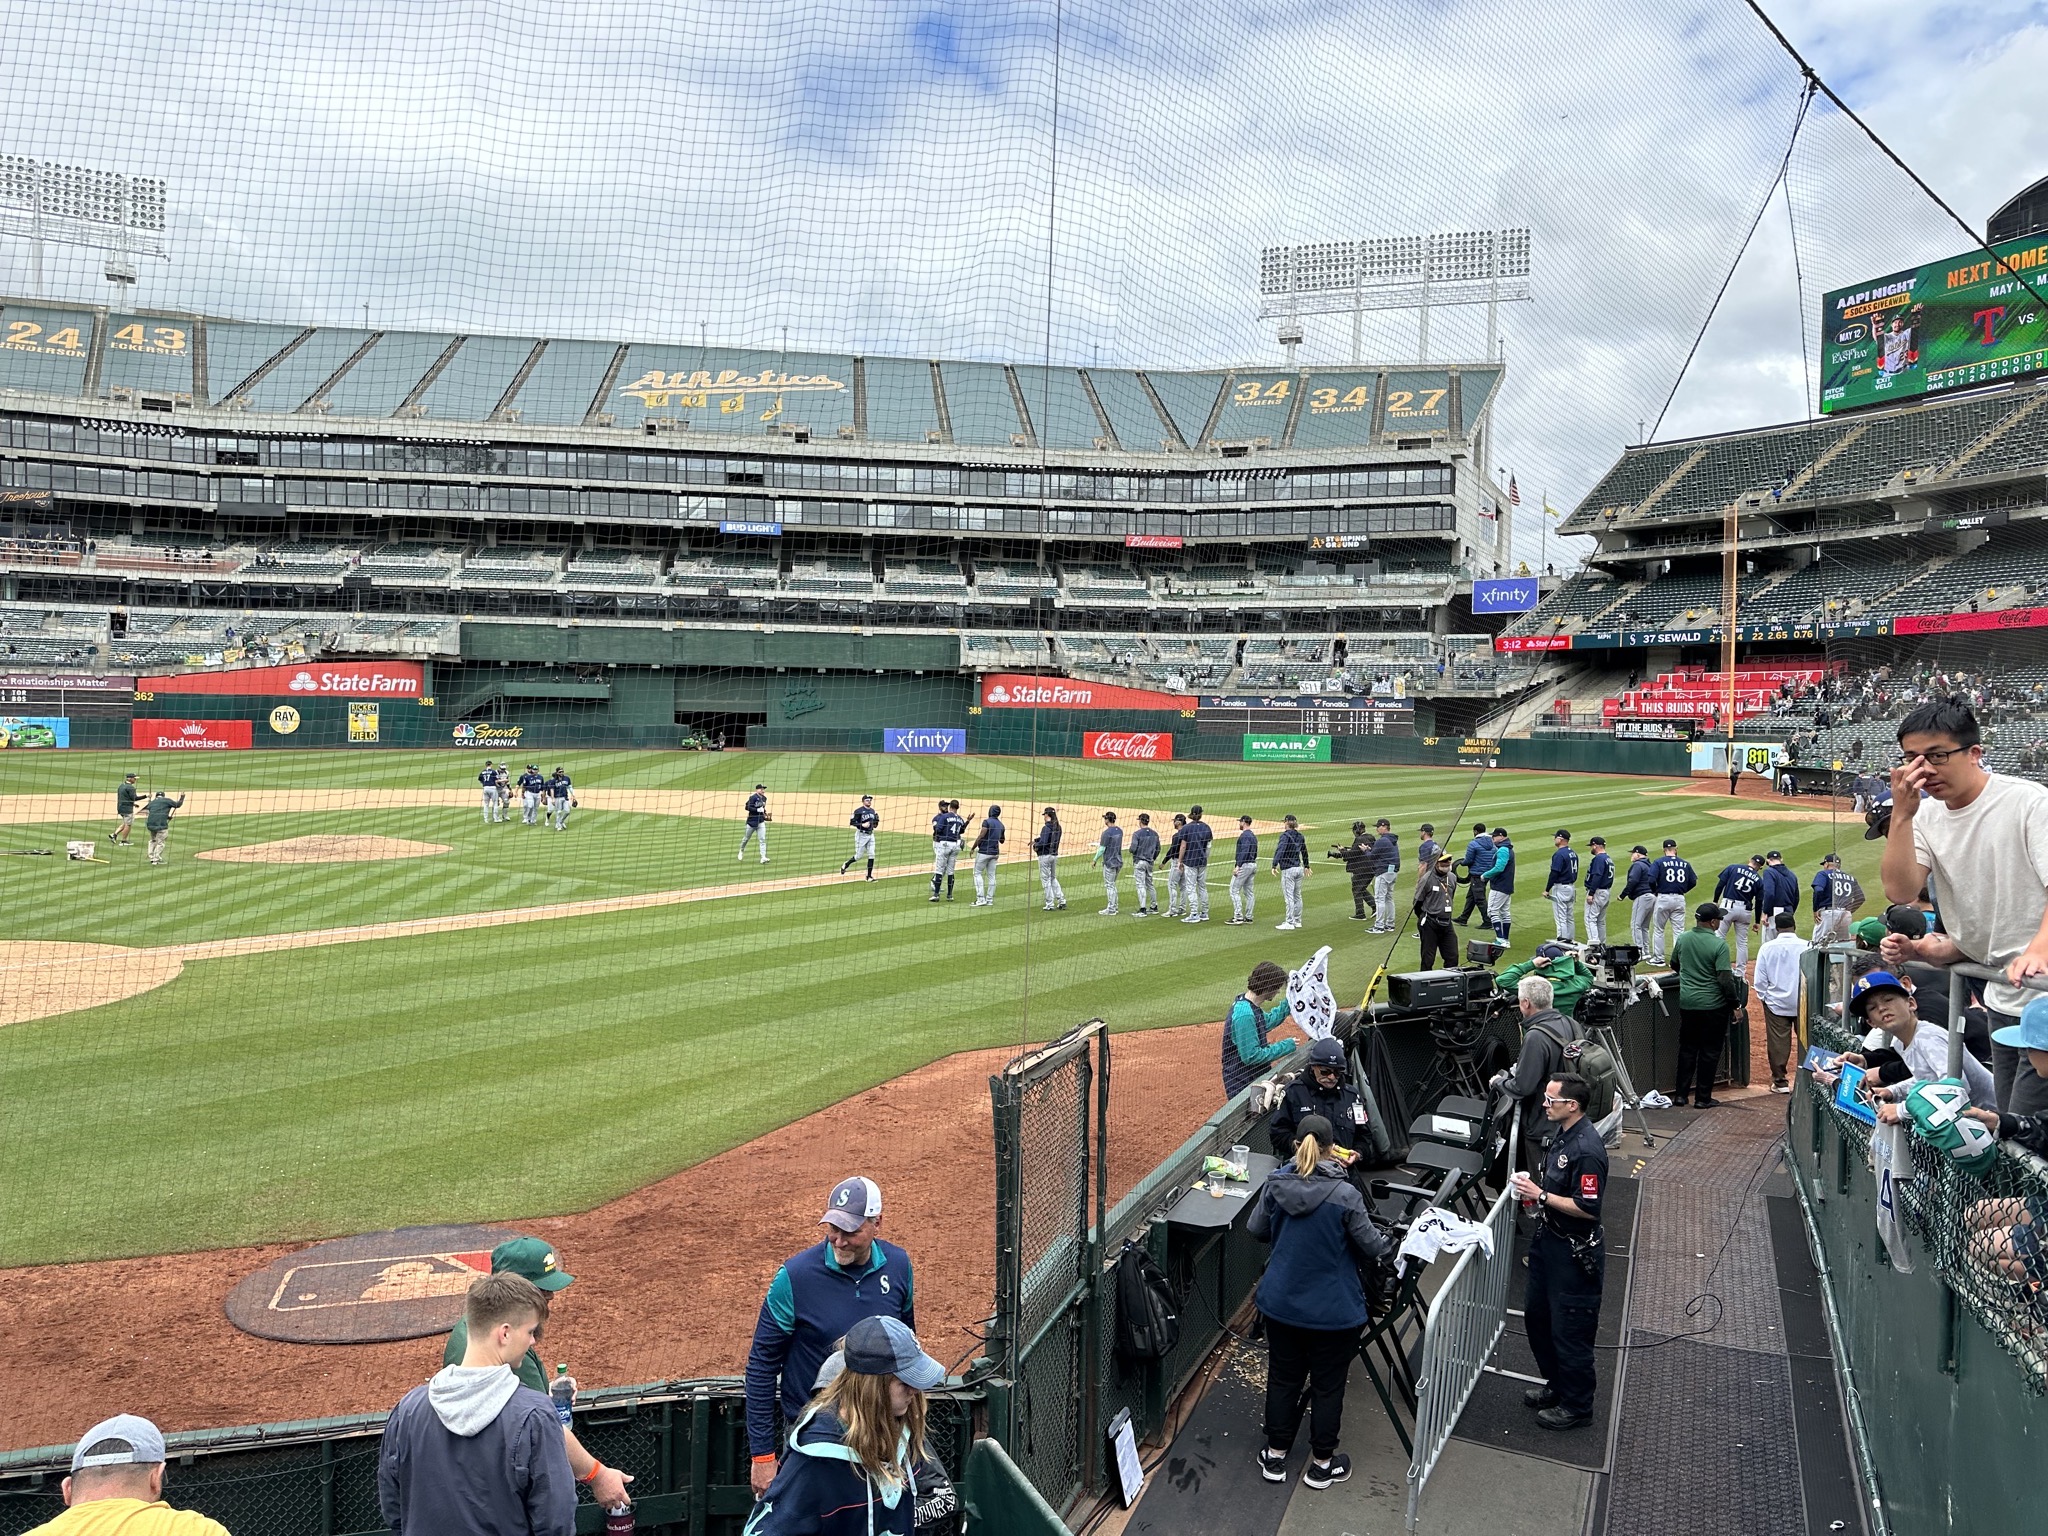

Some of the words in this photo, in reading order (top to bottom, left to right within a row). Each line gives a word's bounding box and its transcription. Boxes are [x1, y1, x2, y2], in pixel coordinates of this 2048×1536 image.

[1947, 261, 1991, 289] NEXT
[1996, 245, 2048, 276] HOME
[1837, 291, 1870, 310] AAPI
[1872, 278, 1917, 300] NIGHT
[1989, 282, 2014, 298] MAY
[1850, 304, 1871, 317] SOCKS
[1873, 294, 1908, 311] GIVEAWAY
[6, 321, 83, 349] 24
[114, 323, 187, 350] 43
[1839, 329, 1853, 343] MAY
[1853, 328, 1861, 339] 12
[110, 342, 189, 357] ECKERSLEY
[1927, 373, 1943, 382] SEA
[2036, 352, 2042, 360] 0
[1876, 376, 1892, 384] EXIT
[1927, 382, 1944, 391] OAK
[1948, 379, 1954, 387] 0
[2024, 363, 2031, 371] 0
[2035, 361, 2042, 369] 0
[619, 369, 844, 397] Athletics
[1874, 382, 1893, 390] VELO
[1234, 380, 1290, 401] 34
[1824, 392, 1845, 401] SPEED
[1825, 386, 1844, 395] PITCH
[1235, 398, 1282, 407] FINGERS
[1310, 386, 1370, 408] 34
[1387, 389, 1448, 412] 27
[1311, 405, 1364, 414] STEWART
[1392, 409, 1439, 417] HUNTER
[0, 490, 51, 503] Treehouse
[1958, 516, 1986, 525] VALLEY
[726, 523, 746, 532] BUD
[748, 523, 776, 533] LIGHT
[1128, 536, 1180, 548] Budweiser
[1310, 536, 1325, 548] A's
[1481, 587, 1530, 606] xfinity
[1643, 634, 1655, 643] 37
[1657, 632, 1701, 643] SEWALD
[1737, 633, 1743, 641] 4
[1768, 632, 1788, 640] 2.65
[1793, 631, 1813, 639] 0.76
[1828, 629, 1834, 637] 3
[1503, 640, 1521, 649] 3:12
[10, 677, 74, 687] Relationships
[77, 678, 109, 686] Matter
[1167, 677, 1186, 691] SELL
[1299, 682, 1318, 694] SELL
[134, 692, 154, 701] 362
[418, 697, 434, 706] 388
[968, 707, 982, 715] 388
[1181, 710, 1195, 718] 362
[1640, 702, 1664, 713] THIS
[1666, 702, 1695, 714] BUDS
[275, 711, 295, 721] RAY
[474, 724, 524, 738] Sports
[1615, 722, 1627, 731] HIT
[1628, 723, 1642, 732] THE
[1642, 723, 1662, 732] BUDS
[351, 732, 376, 740] FIELD
[897, 731, 953, 752] xfinity
[1423, 737, 1439, 746] 367
[455, 738, 518, 747] CALIFORNIA
[1094, 733, 1161, 758] Coca-Cola
[1252, 741, 1278, 749] EVA
[1279, 742, 1302, 750] AIR
[1748, 749, 1769, 764] 811
[1570, 859, 1578, 874] 14
[1665, 868, 1686, 883] 88
[1734, 876, 1755, 893] 45
[1834, 880, 1852, 897] 89
[836, 1188, 850, 1207] S
[880, 1274, 890, 1295] S
